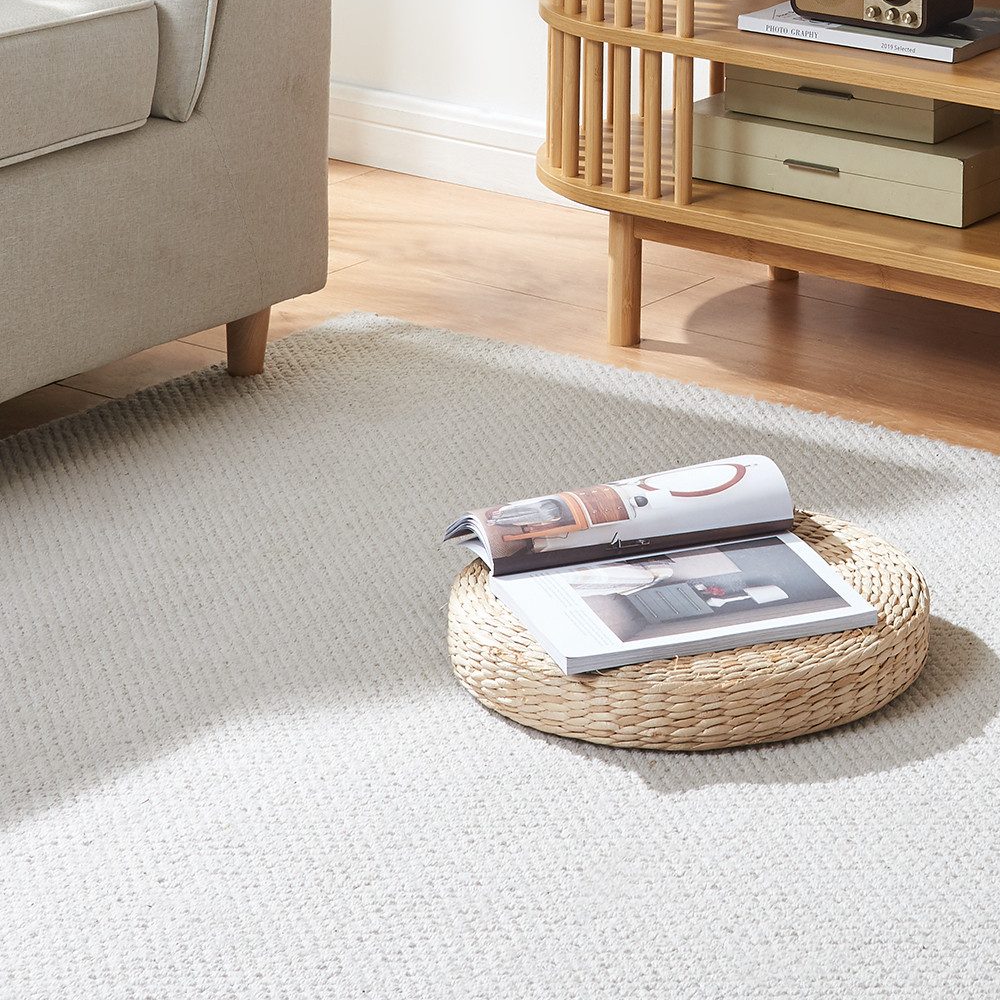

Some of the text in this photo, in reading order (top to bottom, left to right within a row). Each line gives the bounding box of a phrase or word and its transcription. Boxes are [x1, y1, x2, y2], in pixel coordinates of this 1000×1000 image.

[765, 24, 820, 39] PHOTO GRAPHY
[880, 42, 916, 54] 2019 Selected
